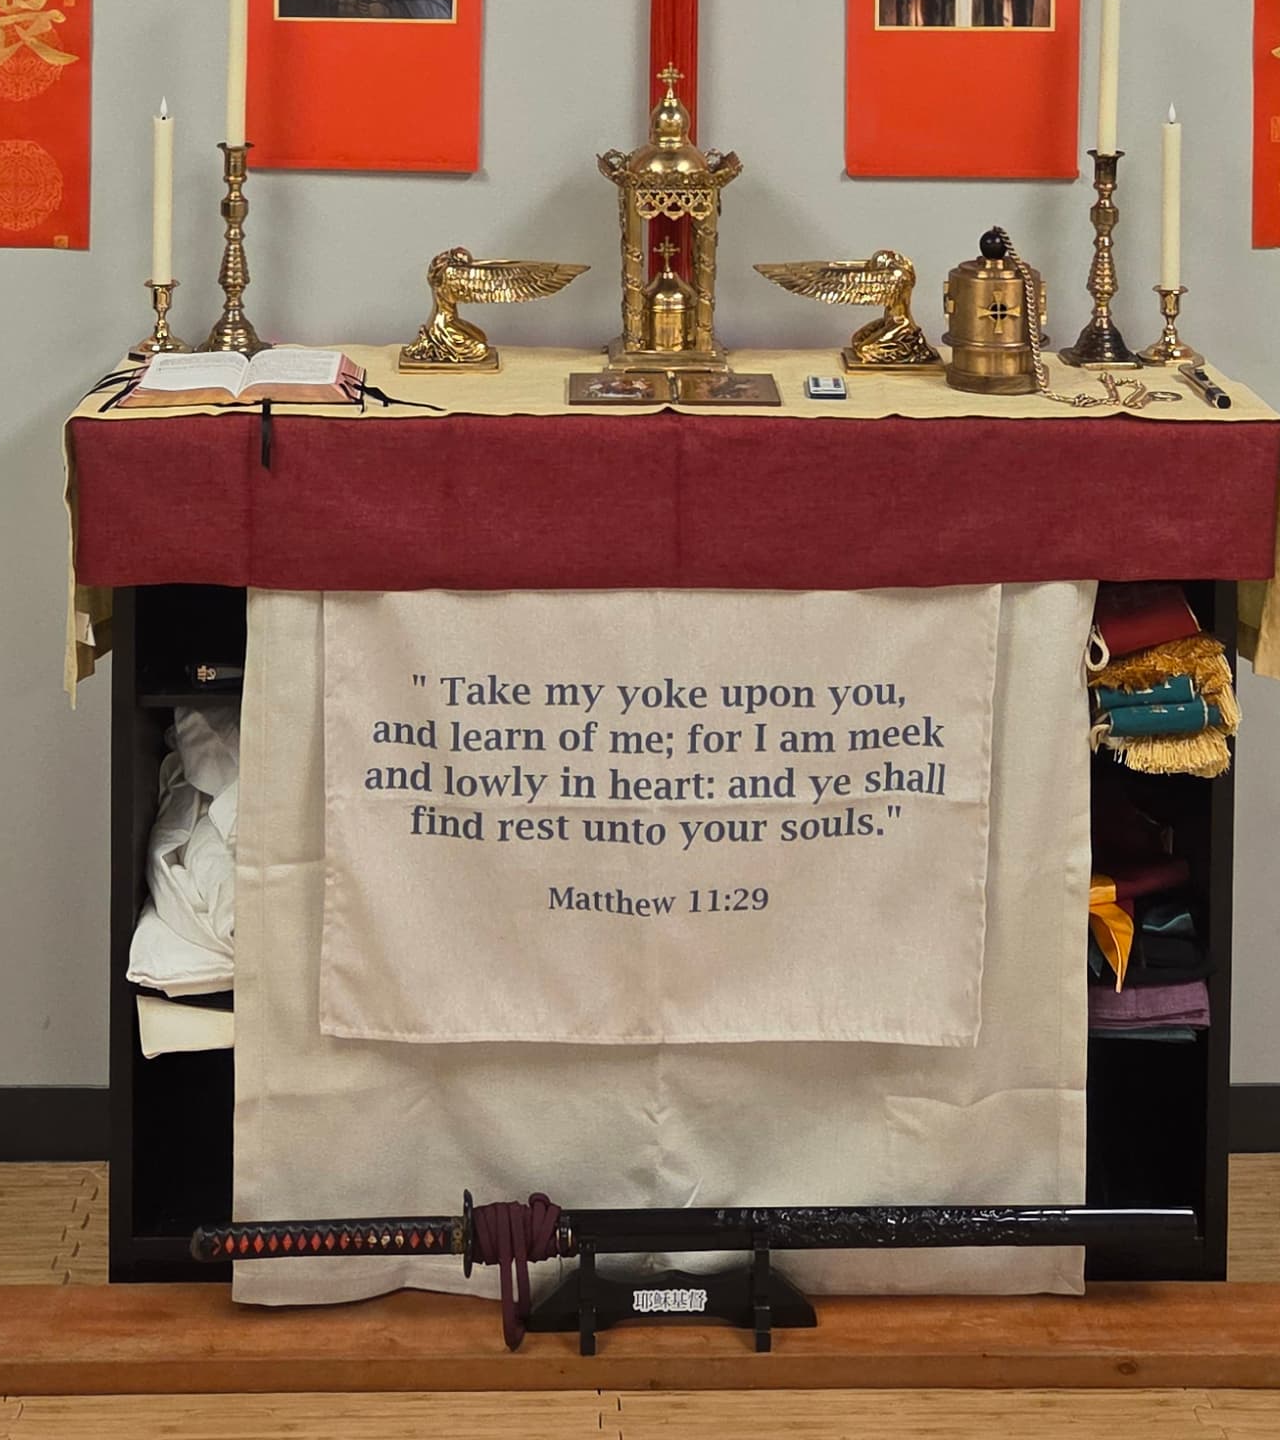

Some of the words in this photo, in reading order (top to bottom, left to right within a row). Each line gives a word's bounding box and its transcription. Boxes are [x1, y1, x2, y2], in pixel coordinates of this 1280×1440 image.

[439, 674, 531, 707] Take
[544, 683, 606, 714] my
[616, 677, 708, 716] yoke
[719, 684, 817, 715] upon
[827, 683, 906, 716] you,
[372, 719, 438, 750] and
[449, 721, 547, 752] learn
[558, 720, 599, 753] of
[608, 730, 674, 760] me;
[686, 723, 743, 755] for
[754, 723, 768, 753] I
[779, 730, 836, 753] am
[847, 715, 945, 752] meek
[364, 760, 433, 793] and
[443, 765, 549, 804] lowly
[559, 765, 596, 799] in
[608, 767, 715, 801] heart:
[728, 766, 796, 799] and
[807, 774, 851, 805] ye
[864, 761, 946, 796] shall
[410, 804, 485, 841] find
[497, 815, 570, 842] rest
[581, 818, 666, 846] unto
[678, 819, 768, 851] your
[780, 804, 902, 842] souls."
[548, 886, 677, 918] Matthew
[688, 887, 769, 913] 11:29
